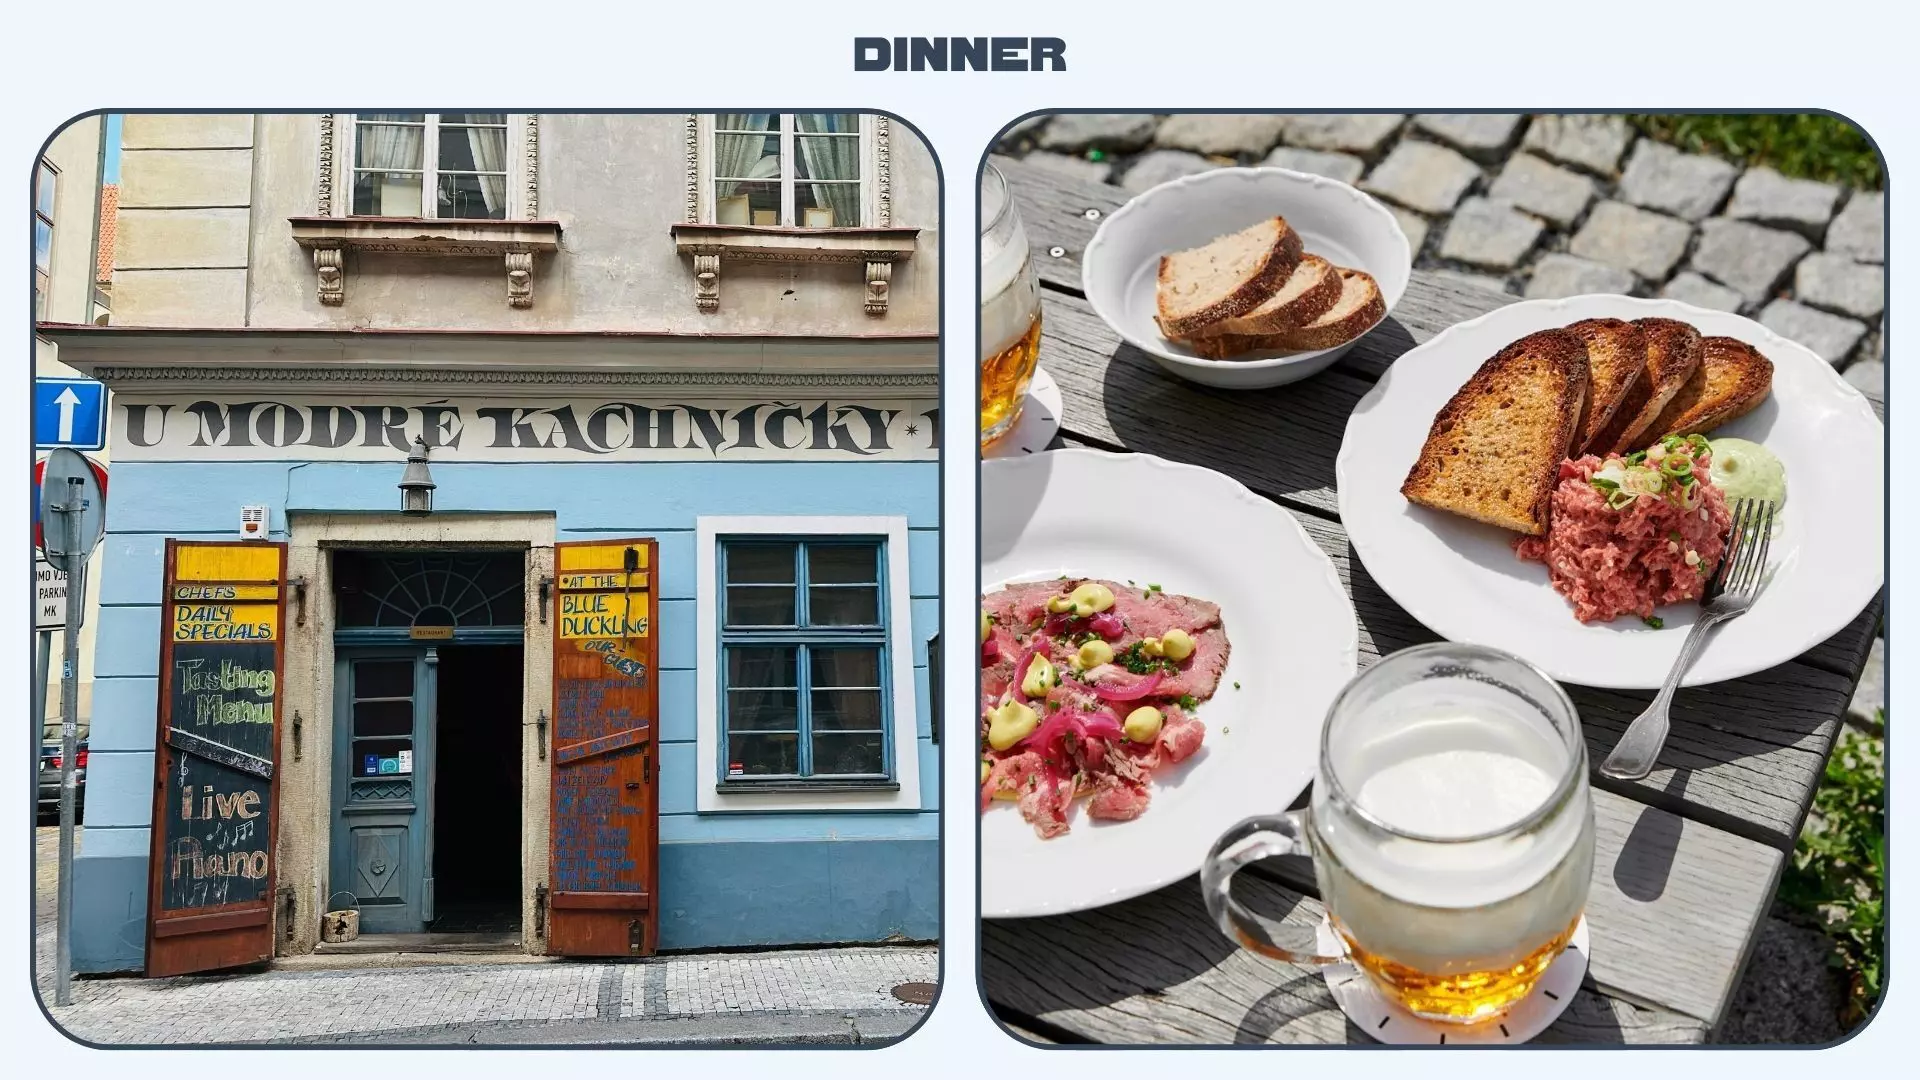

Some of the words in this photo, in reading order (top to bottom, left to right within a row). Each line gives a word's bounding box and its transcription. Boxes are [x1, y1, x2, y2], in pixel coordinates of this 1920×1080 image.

[120, 404, 176, 447] U
[184, 399, 465, 452] MODRÉ
[476, 400, 903, 458] KACHNIČKY
[569, 576, 586, 588] AT
[591, 575, 617, 588] THE
[43, 605, 57, 617] MK
[177, 605, 232, 622] DAILY
[562, 594, 611, 614] BLUE
[175, 623, 273, 640] SPECIALS
[176, 658, 276, 698] Tasting
[196, 693, 275, 727] Menu
[181, 784, 262, 821] Live
